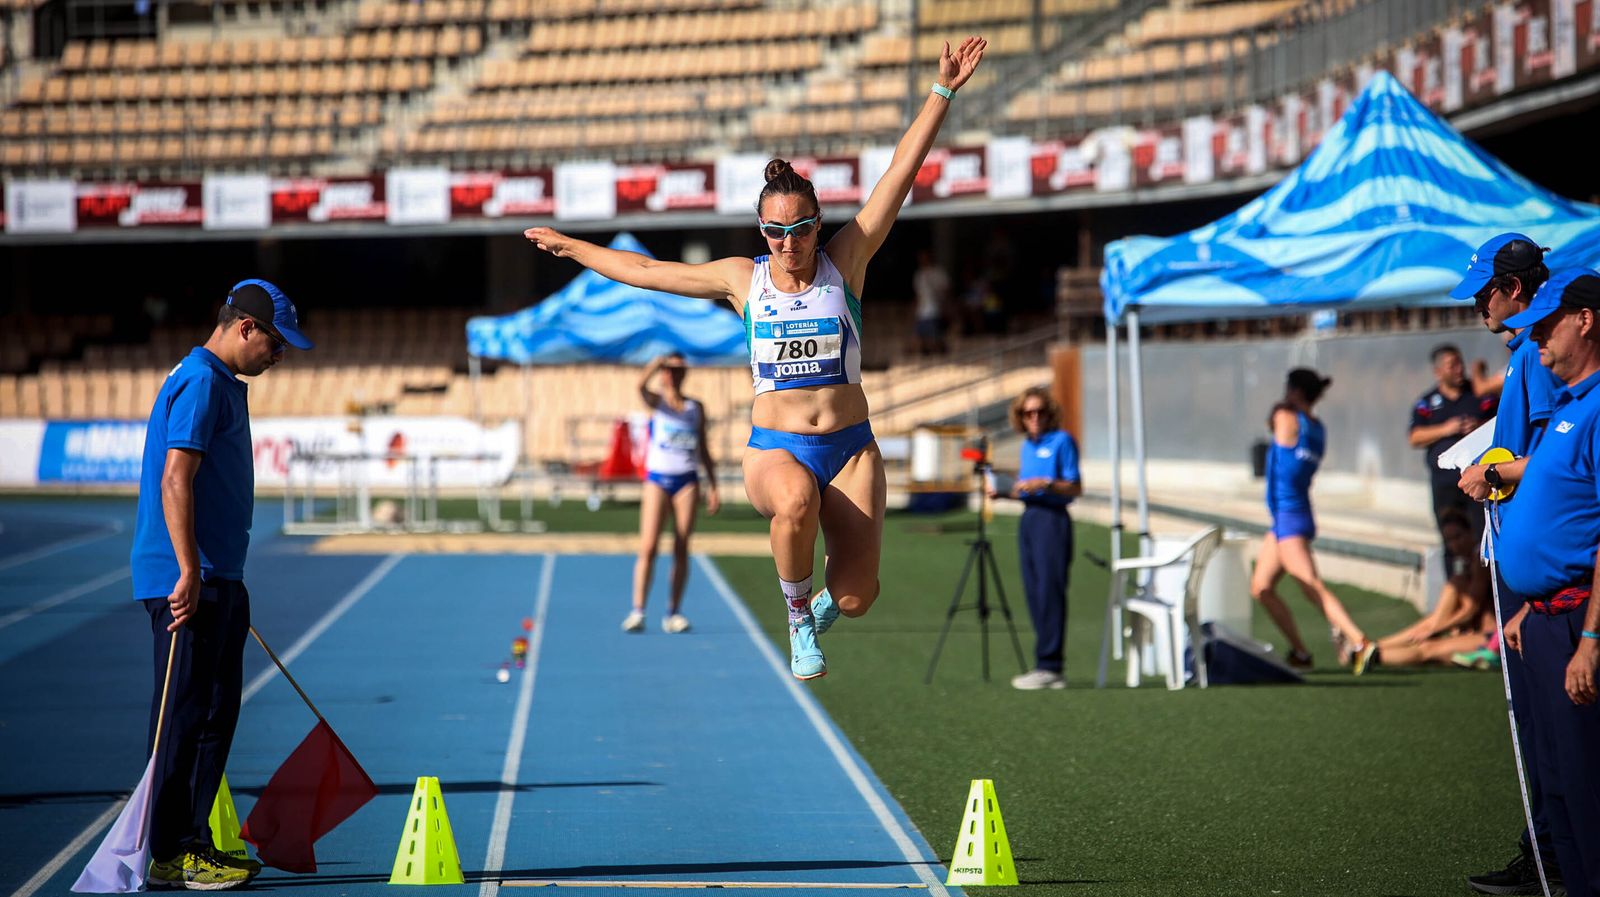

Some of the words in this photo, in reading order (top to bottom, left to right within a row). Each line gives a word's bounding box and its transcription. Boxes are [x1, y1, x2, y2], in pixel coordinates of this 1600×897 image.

[786, 321, 819, 329] LOTERÍAS
[774, 339, 818, 361] 780
[955, 867, 983, 875] KIPSTA
